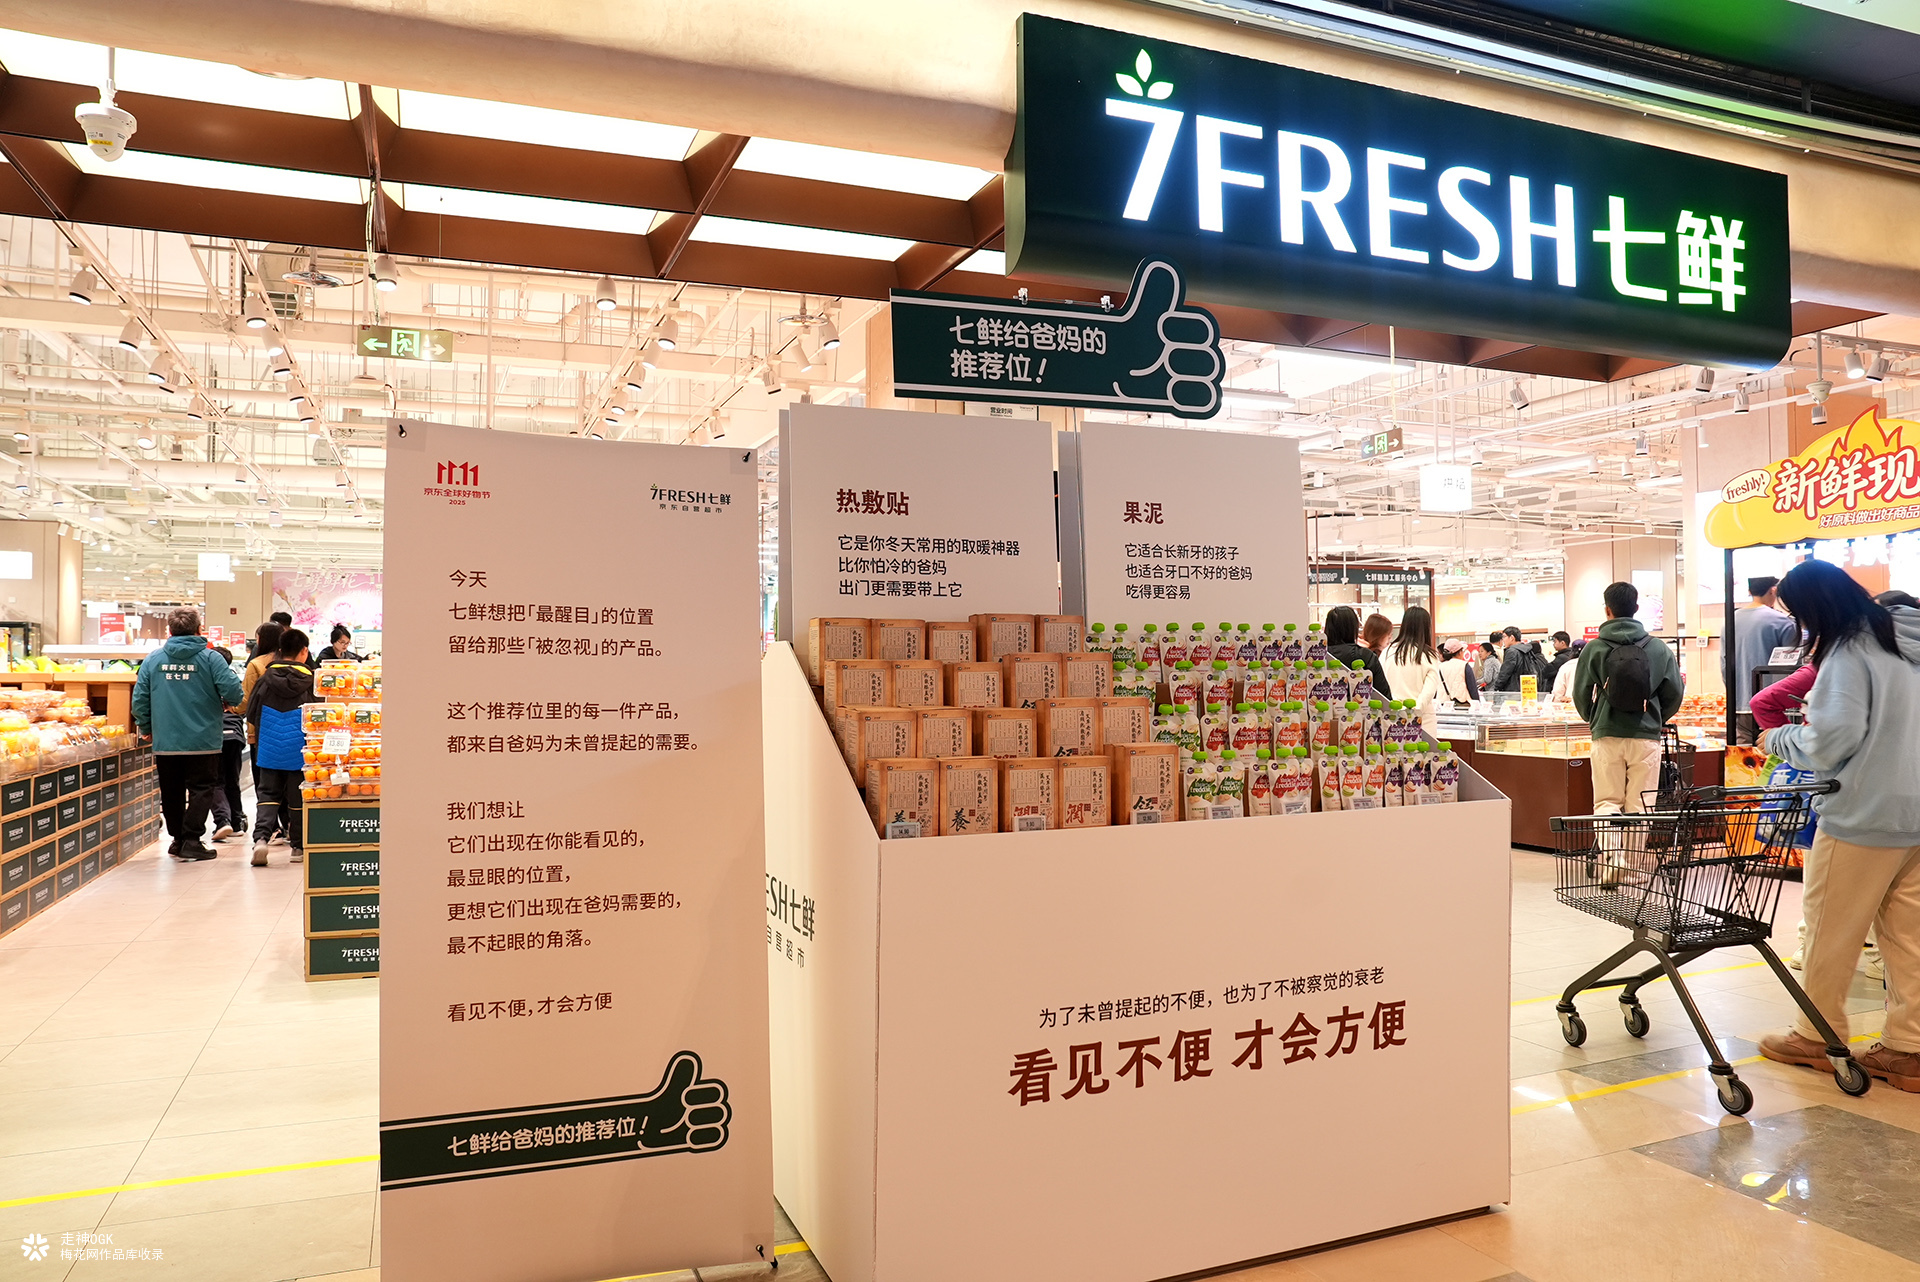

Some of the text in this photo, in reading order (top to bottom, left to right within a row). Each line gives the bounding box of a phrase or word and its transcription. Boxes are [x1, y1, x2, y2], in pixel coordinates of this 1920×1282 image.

[1105, 98, 1747, 312] 7FRESH 七鲜
[949, 315, 1107, 355] 七鲜给爸妈的
[950, 349, 1048, 384] 推荐位！
[424, 487, 491, 499] 京东全球好物节
[1726, 473, 1766, 500] freshly!
[1775, 448, 1920, 519] 新鲜现
[650, 488, 731, 506] 7FRESH 七鲜
[659, 503, 722, 514] 京东自营超市
[836, 489, 910, 516] 热敷贴
[1123, 501, 1165, 525] 果泥
[1819, 506, 1920, 528] 好原料做出好商品
[838, 534, 1020, 557] 它是你冬天常用的取暖神器
[1124, 542, 1240, 561] 它适合长新牙的孩子
[838, 557, 947, 577] 比你怕冷的爸妈
[1124, 562, 1253, 581] 也适合牙口不好的爸妈
[448, 569, 488, 589] 今天
[838, 579, 963, 598] 出门更需要带上它
[1125, 583, 1191, 600] 吃得更容易
[448, 603, 654, 626] 七鲜想把「最醒目」的位置
[448, 635, 662, 657] 留给那些「被忽视」的产品。
[447, 702, 679, 721] 这个推荐位里的每一件产品，
[447, 733, 698, 754] 都来自爸妈为未曾提起的需要。
[447, 801, 525, 821] 我们想让
[447, 829, 645, 854] 它们出现在你能看见的，
[447, 864, 571, 888] 最显眼的位置，
[447, 891, 681, 922] 更想它们出现在爸妈需要的，
[447, 929, 592, 955] 最不起眼的角落。
[447, 992, 613, 1023] 看见不便，才会方便
[1008, 999, 1408, 1107] 看见不便 才会方便
[447, 1116, 649, 1157] 七鲜给爸妈的推荐位！
